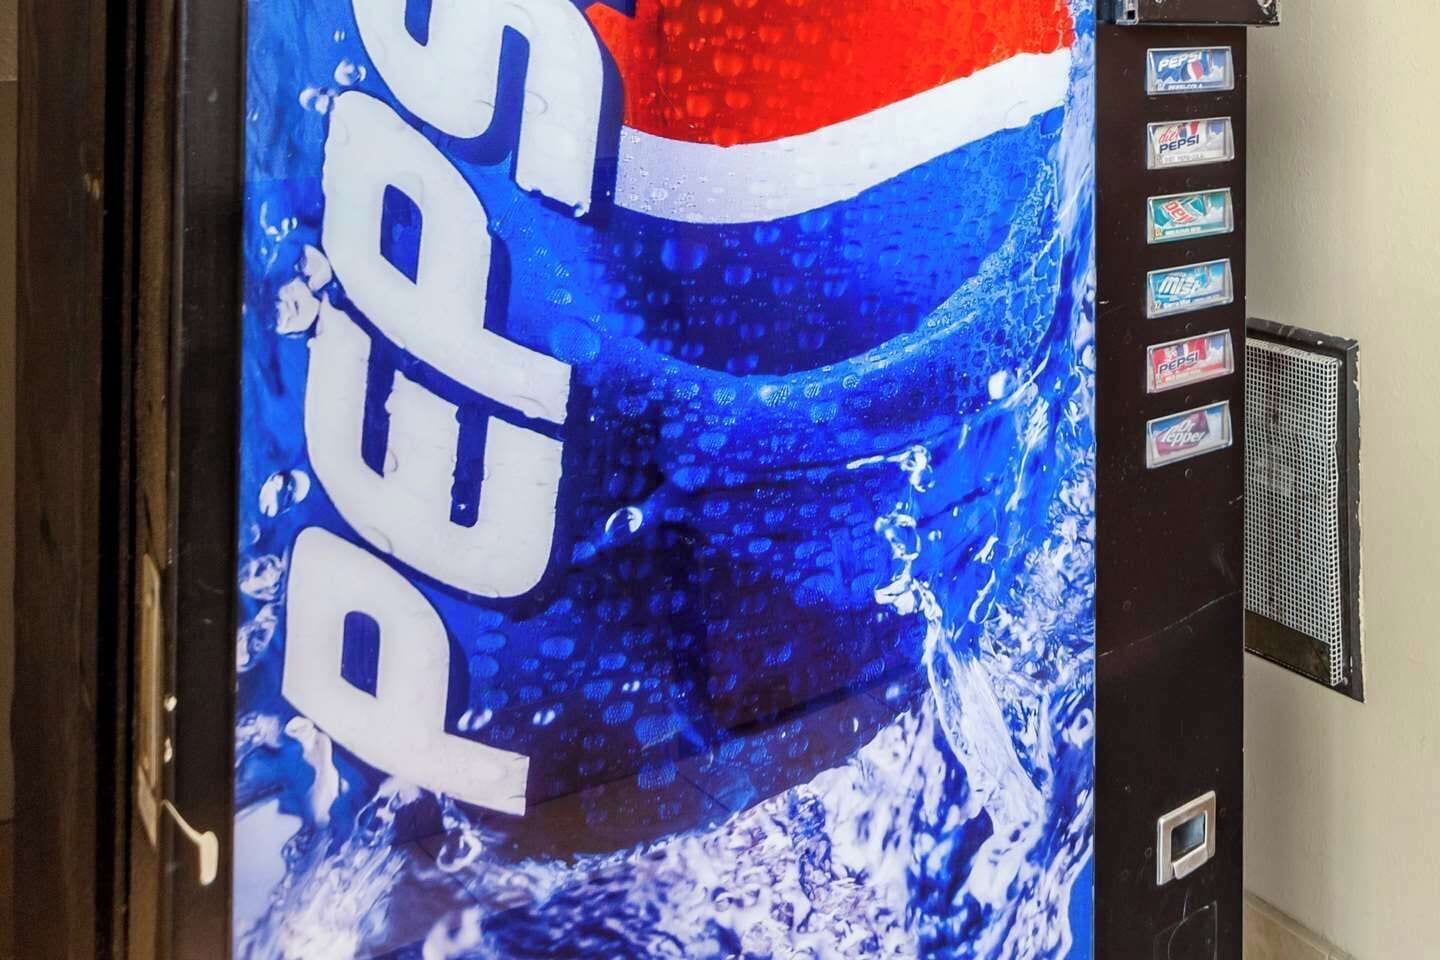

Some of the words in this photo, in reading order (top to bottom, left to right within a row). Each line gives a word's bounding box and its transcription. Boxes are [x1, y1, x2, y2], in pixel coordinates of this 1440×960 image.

[1158, 50, 1202, 73] PEPSI
[1159, 134, 1200, 154] PEPSI
[1159, 351, 1199, 374] PEPSI
[1161, 426, 1206, 447] Pepper
[1177, 419, 1196, 433] Dr
